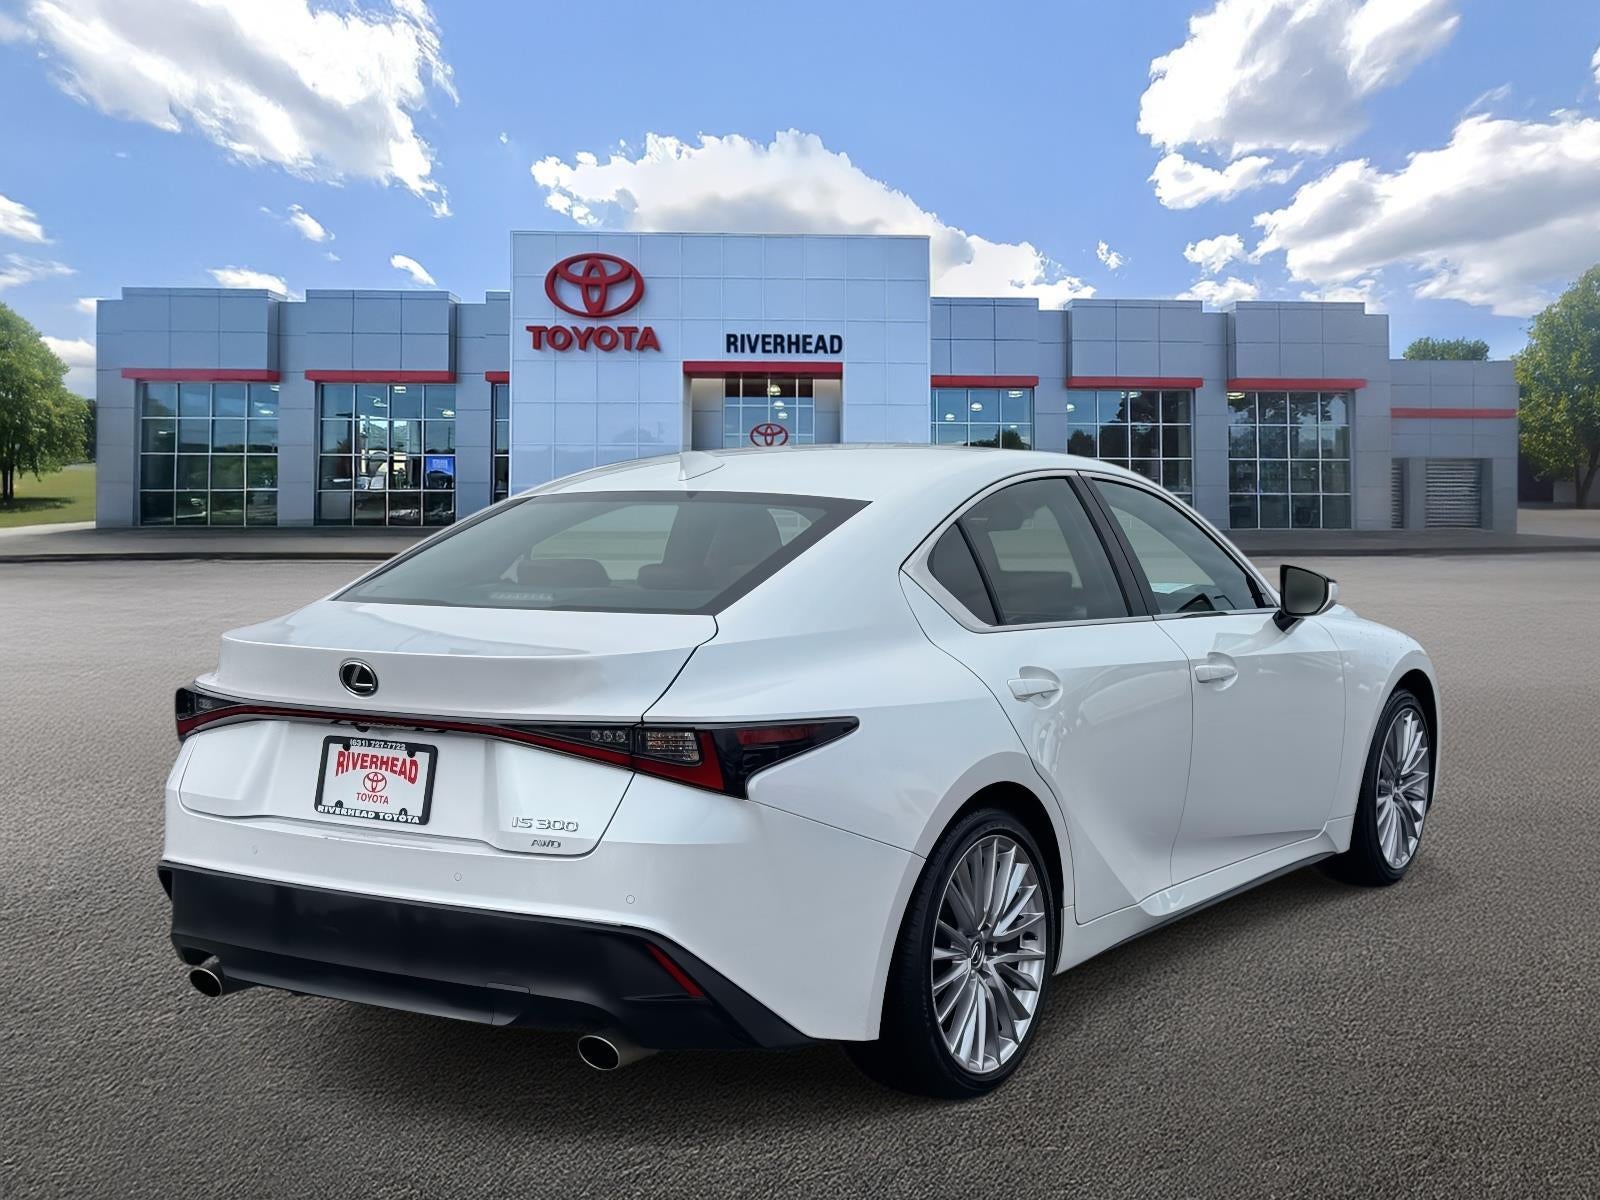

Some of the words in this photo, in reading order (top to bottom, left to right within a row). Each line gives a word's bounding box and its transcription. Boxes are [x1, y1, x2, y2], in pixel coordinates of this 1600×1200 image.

[526, 325, 660, 352] TOYOTA
[725, 332, 844, 355] RIVERHEAD
[350, 738, 369, 748] (631)
[335, 750, 419, 785] RIVERHEAD
[356, 792, 389, 805] TOYOTA
[317, 805, 376, 819] RIVERHEAD
[379, 812, 420, 824] TOYOTA
[511, 816, 533, 829] IS
[535, 819, 579, 832] 300
[530, 839, 562, 849] AWD
